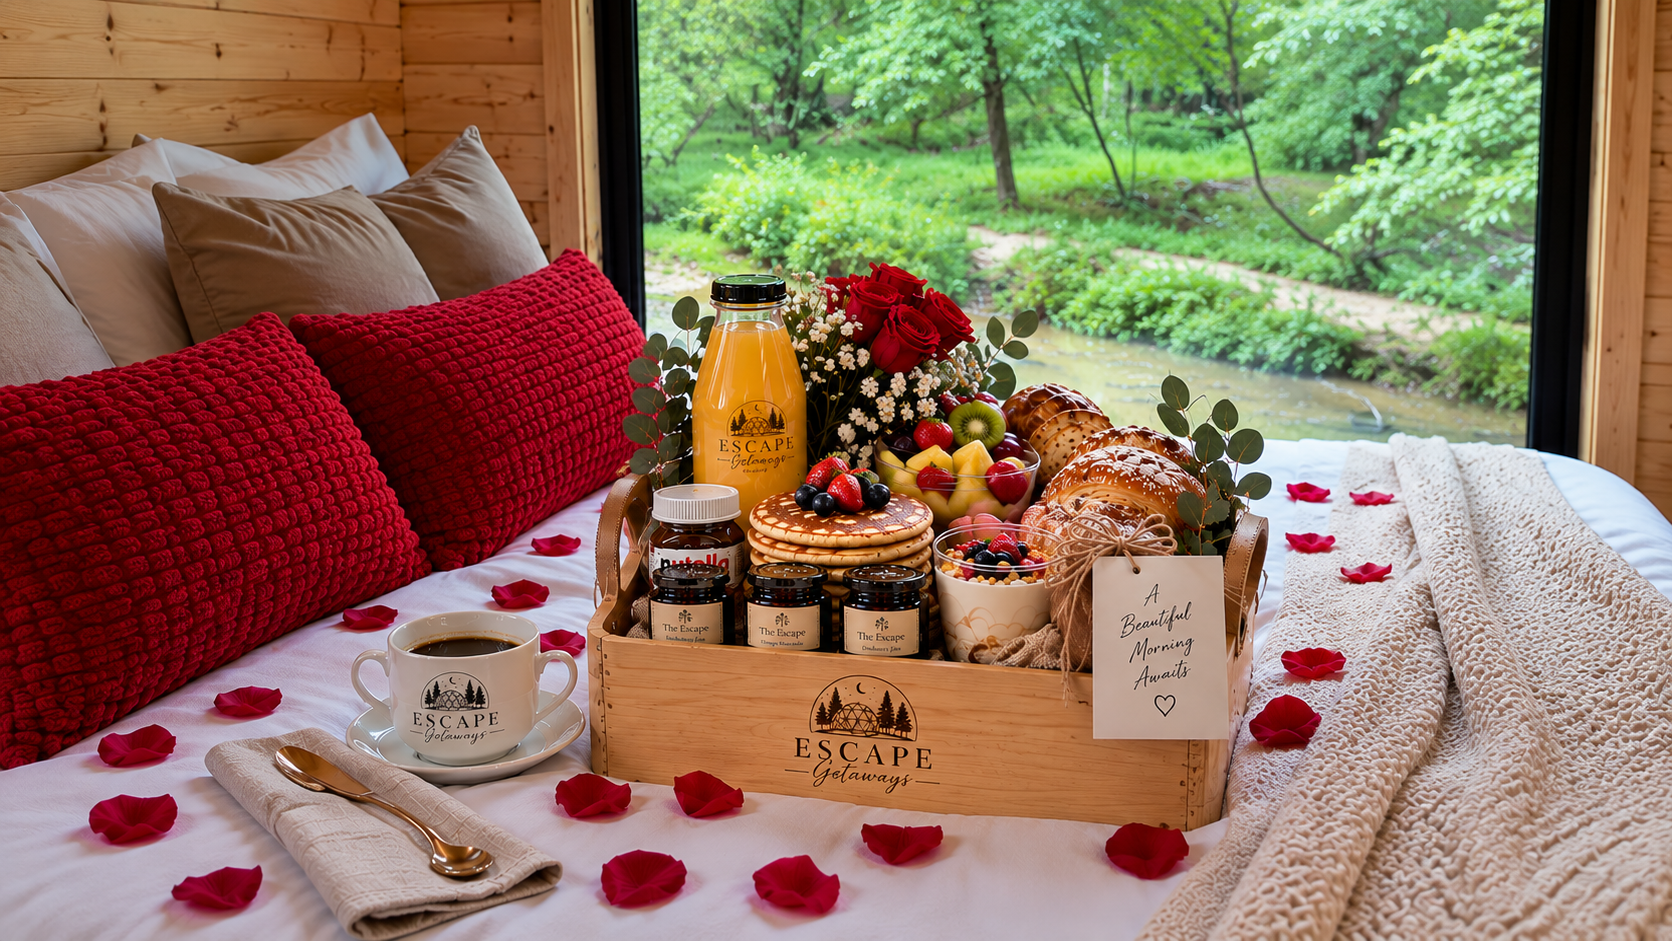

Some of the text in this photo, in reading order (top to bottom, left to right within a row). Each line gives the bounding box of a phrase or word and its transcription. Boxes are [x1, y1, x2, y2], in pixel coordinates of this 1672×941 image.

[718, 436, 794, 453] ESCAPE
[1143, 583, 1160, 607] A
[662, 623, 678, 632] The
[759, 626, 775, 636] The
[1120, 601, 1192, 639] Beautiful
[857, 631, 873, 641] The
[1129, 637, 1195, 663] Morning
[1134, 659, 1191, 690] Awaits
[413, 711, 499, 729] ESCAPE
[794, 737, 932, 769] ESCAPE
[812, 758, 913, 794] Getaways
